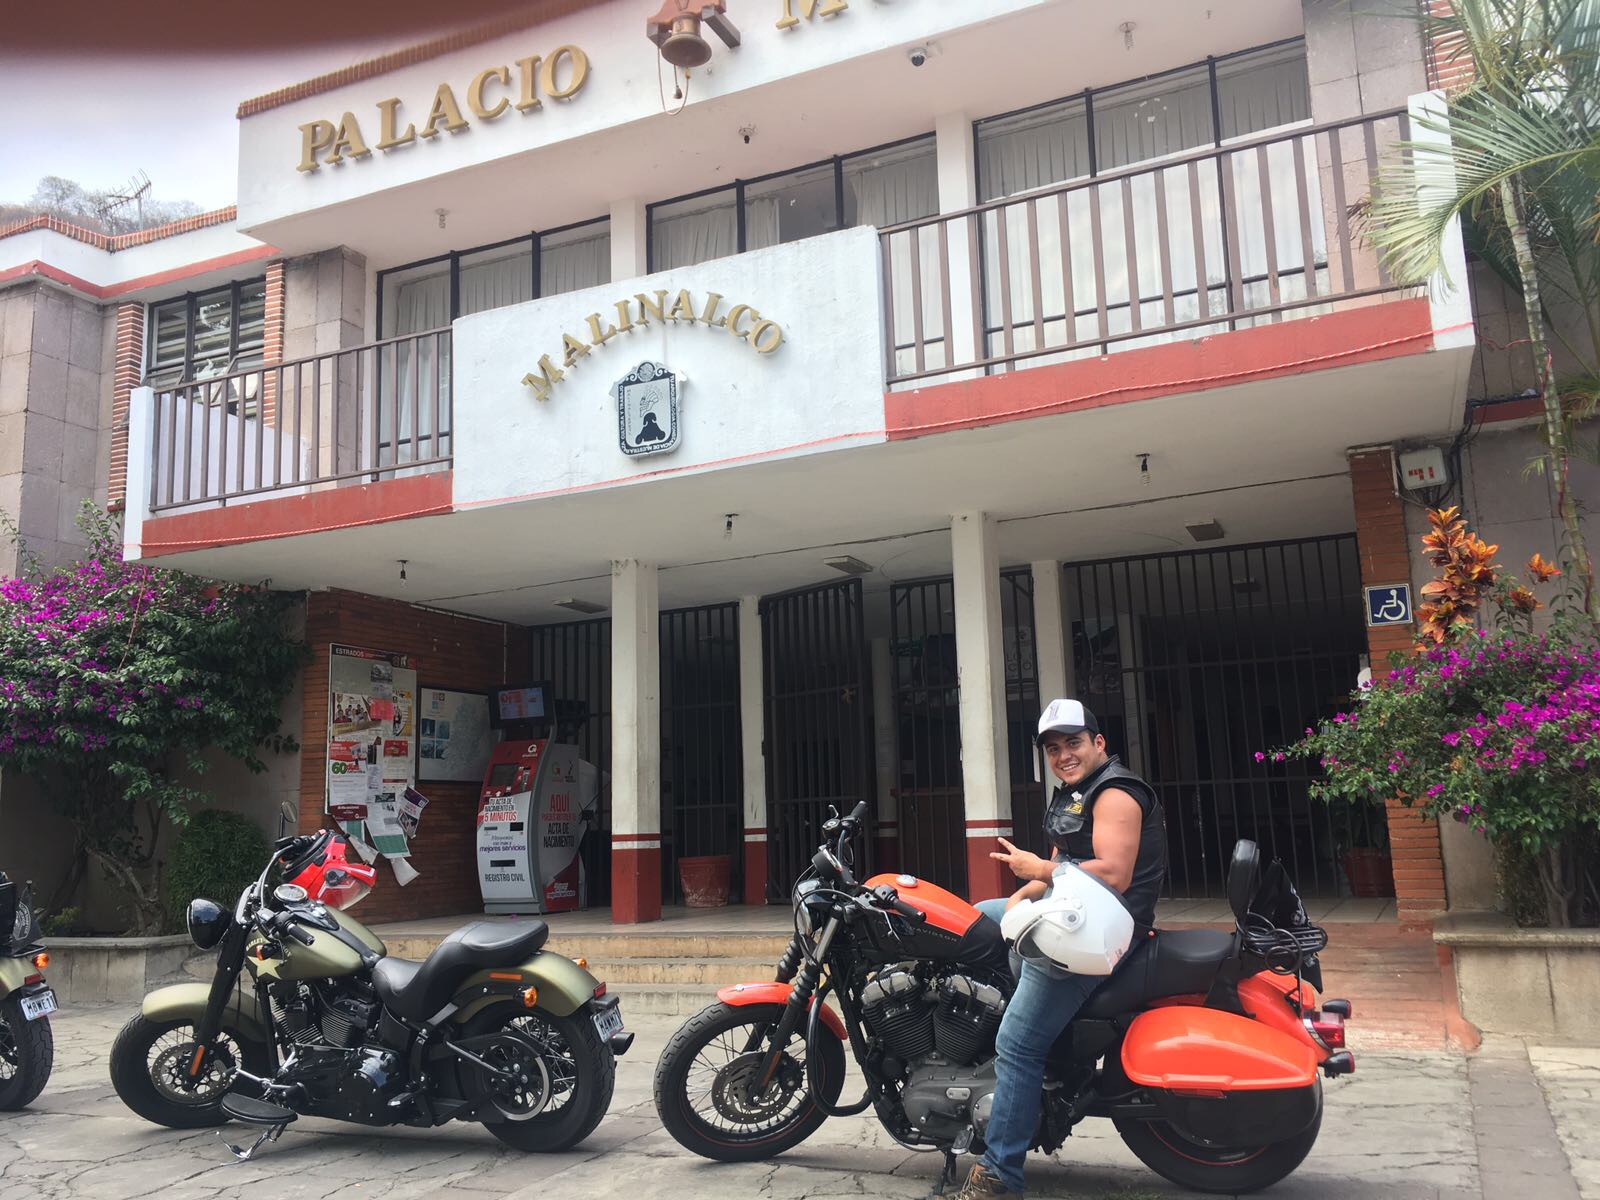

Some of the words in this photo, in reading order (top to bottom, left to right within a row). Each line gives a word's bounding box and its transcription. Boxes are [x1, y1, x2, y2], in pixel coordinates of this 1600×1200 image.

[296, 44, 591, 173] PALACIO
[521, 288, 783, 401] MALINALCO
[336, 648, 365, 658] ESTRADOS
[332, 762, 347, 774] 60
[484, 813, 489, 822] 5
[490, 812, 517, 821] MINUTOS
[548, 823, 562, 835] ACTA
[563, 823, 569, 834] DE
[544, 836, 574, 848] NACIMIENTO
[480, 844, 500, 854] mejores
[485, 874, 510, 882] REGISTRO
[511, 873, 525, 882] CIVIL
